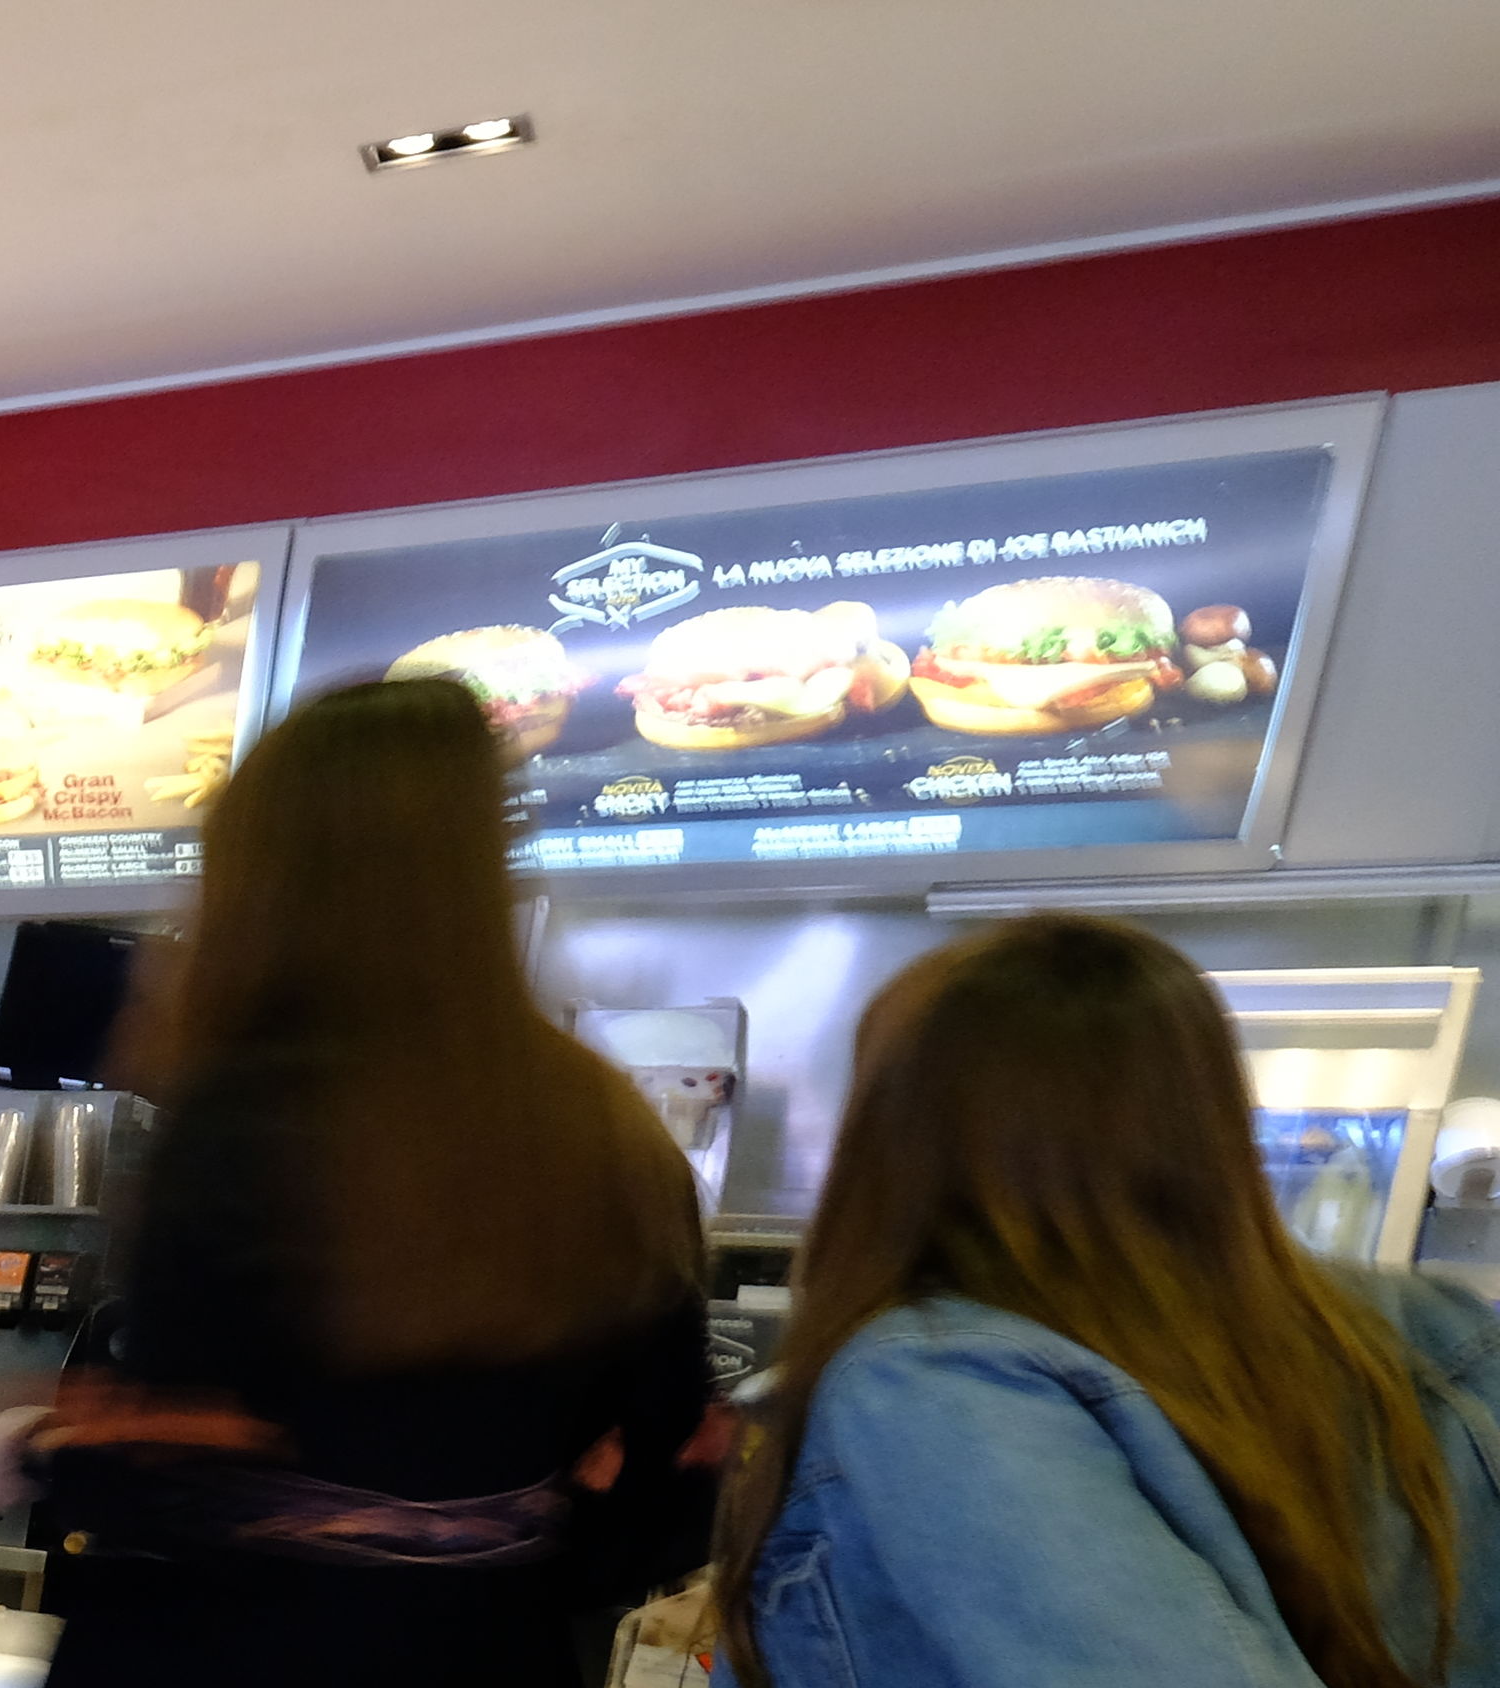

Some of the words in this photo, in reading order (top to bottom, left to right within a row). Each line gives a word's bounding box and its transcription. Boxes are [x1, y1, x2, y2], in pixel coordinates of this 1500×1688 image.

[713, 564, 746, 588] LA
[63, 774, 115, 788] Gran
[907, 773, 1012, 800] CHICKEN
[53, 790, 122, 806] Crispy
[43, 806, 132, 821] McBacon
